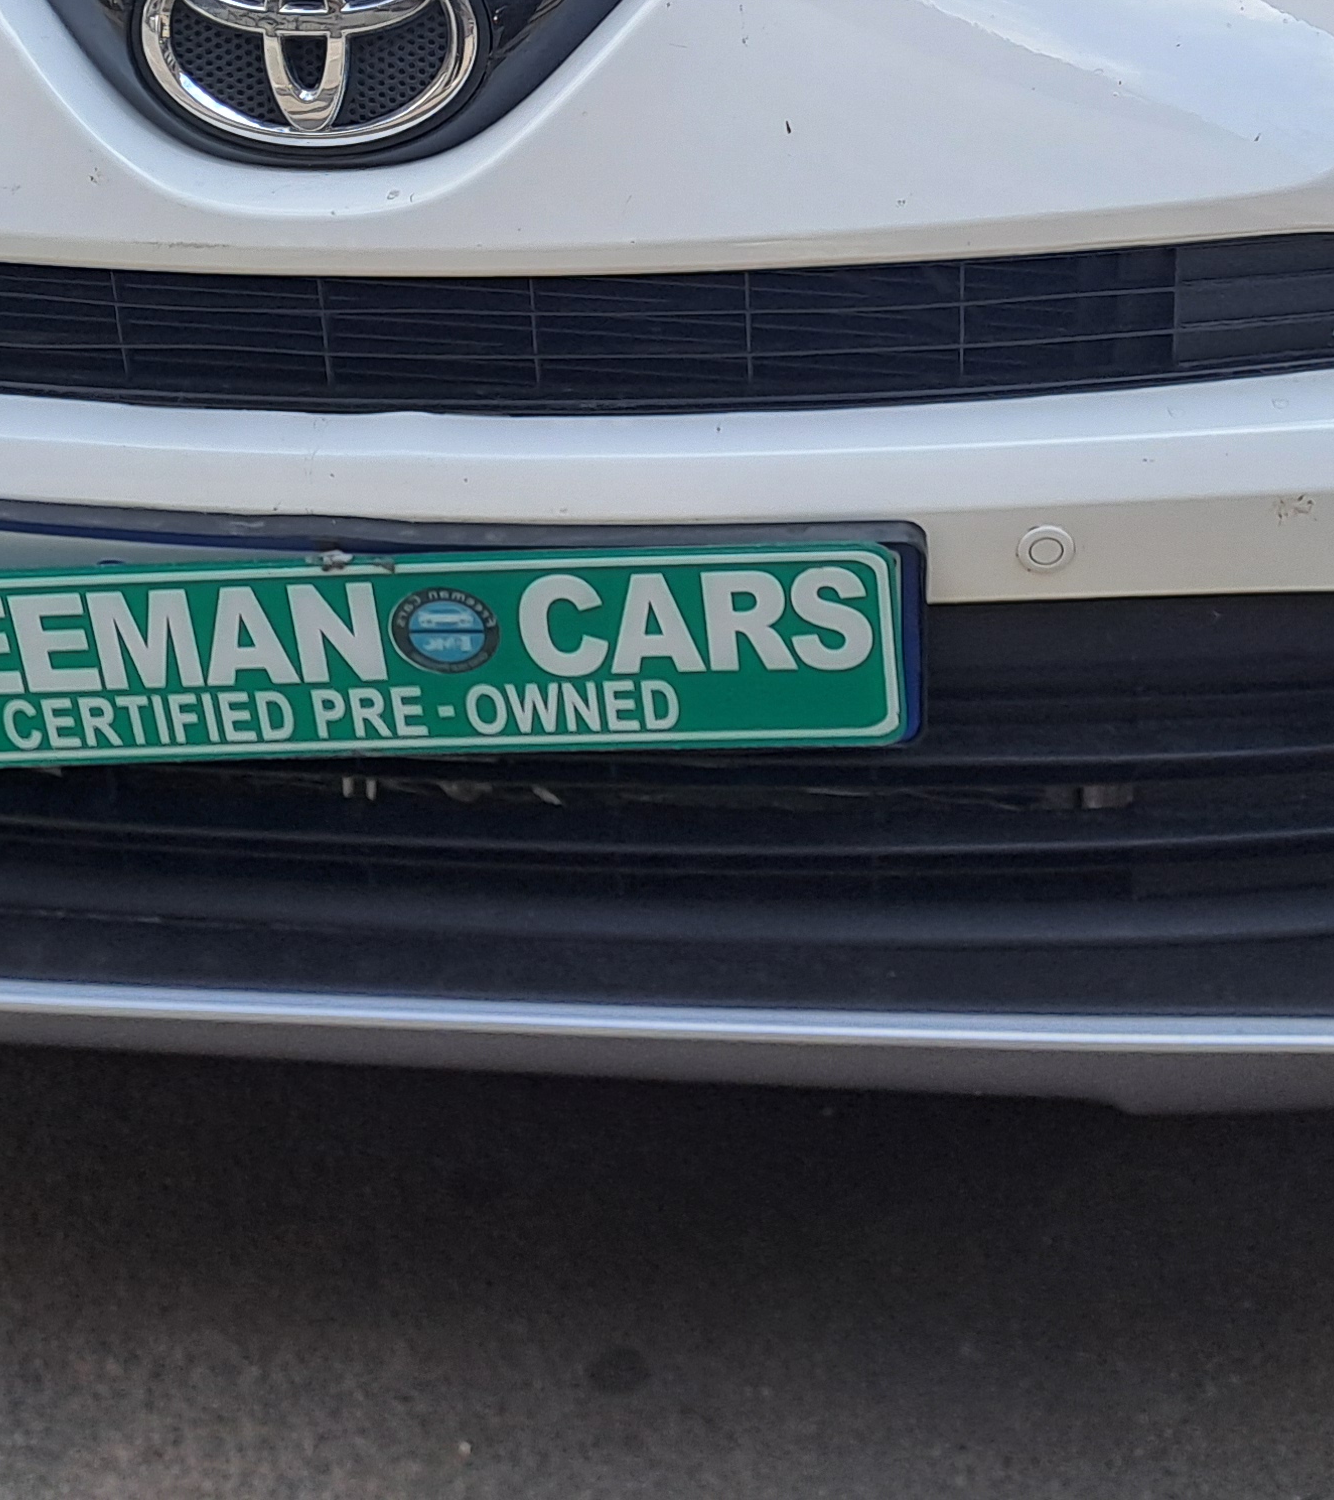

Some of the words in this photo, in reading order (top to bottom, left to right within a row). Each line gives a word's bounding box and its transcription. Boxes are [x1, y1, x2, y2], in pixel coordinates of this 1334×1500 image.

[518, 566, 874, 677] CARS
[3, 691, 294, 750] CERTIFIED
[311, 686, 430, 740] PRE
[467, 680, 680, 736] OWNED
